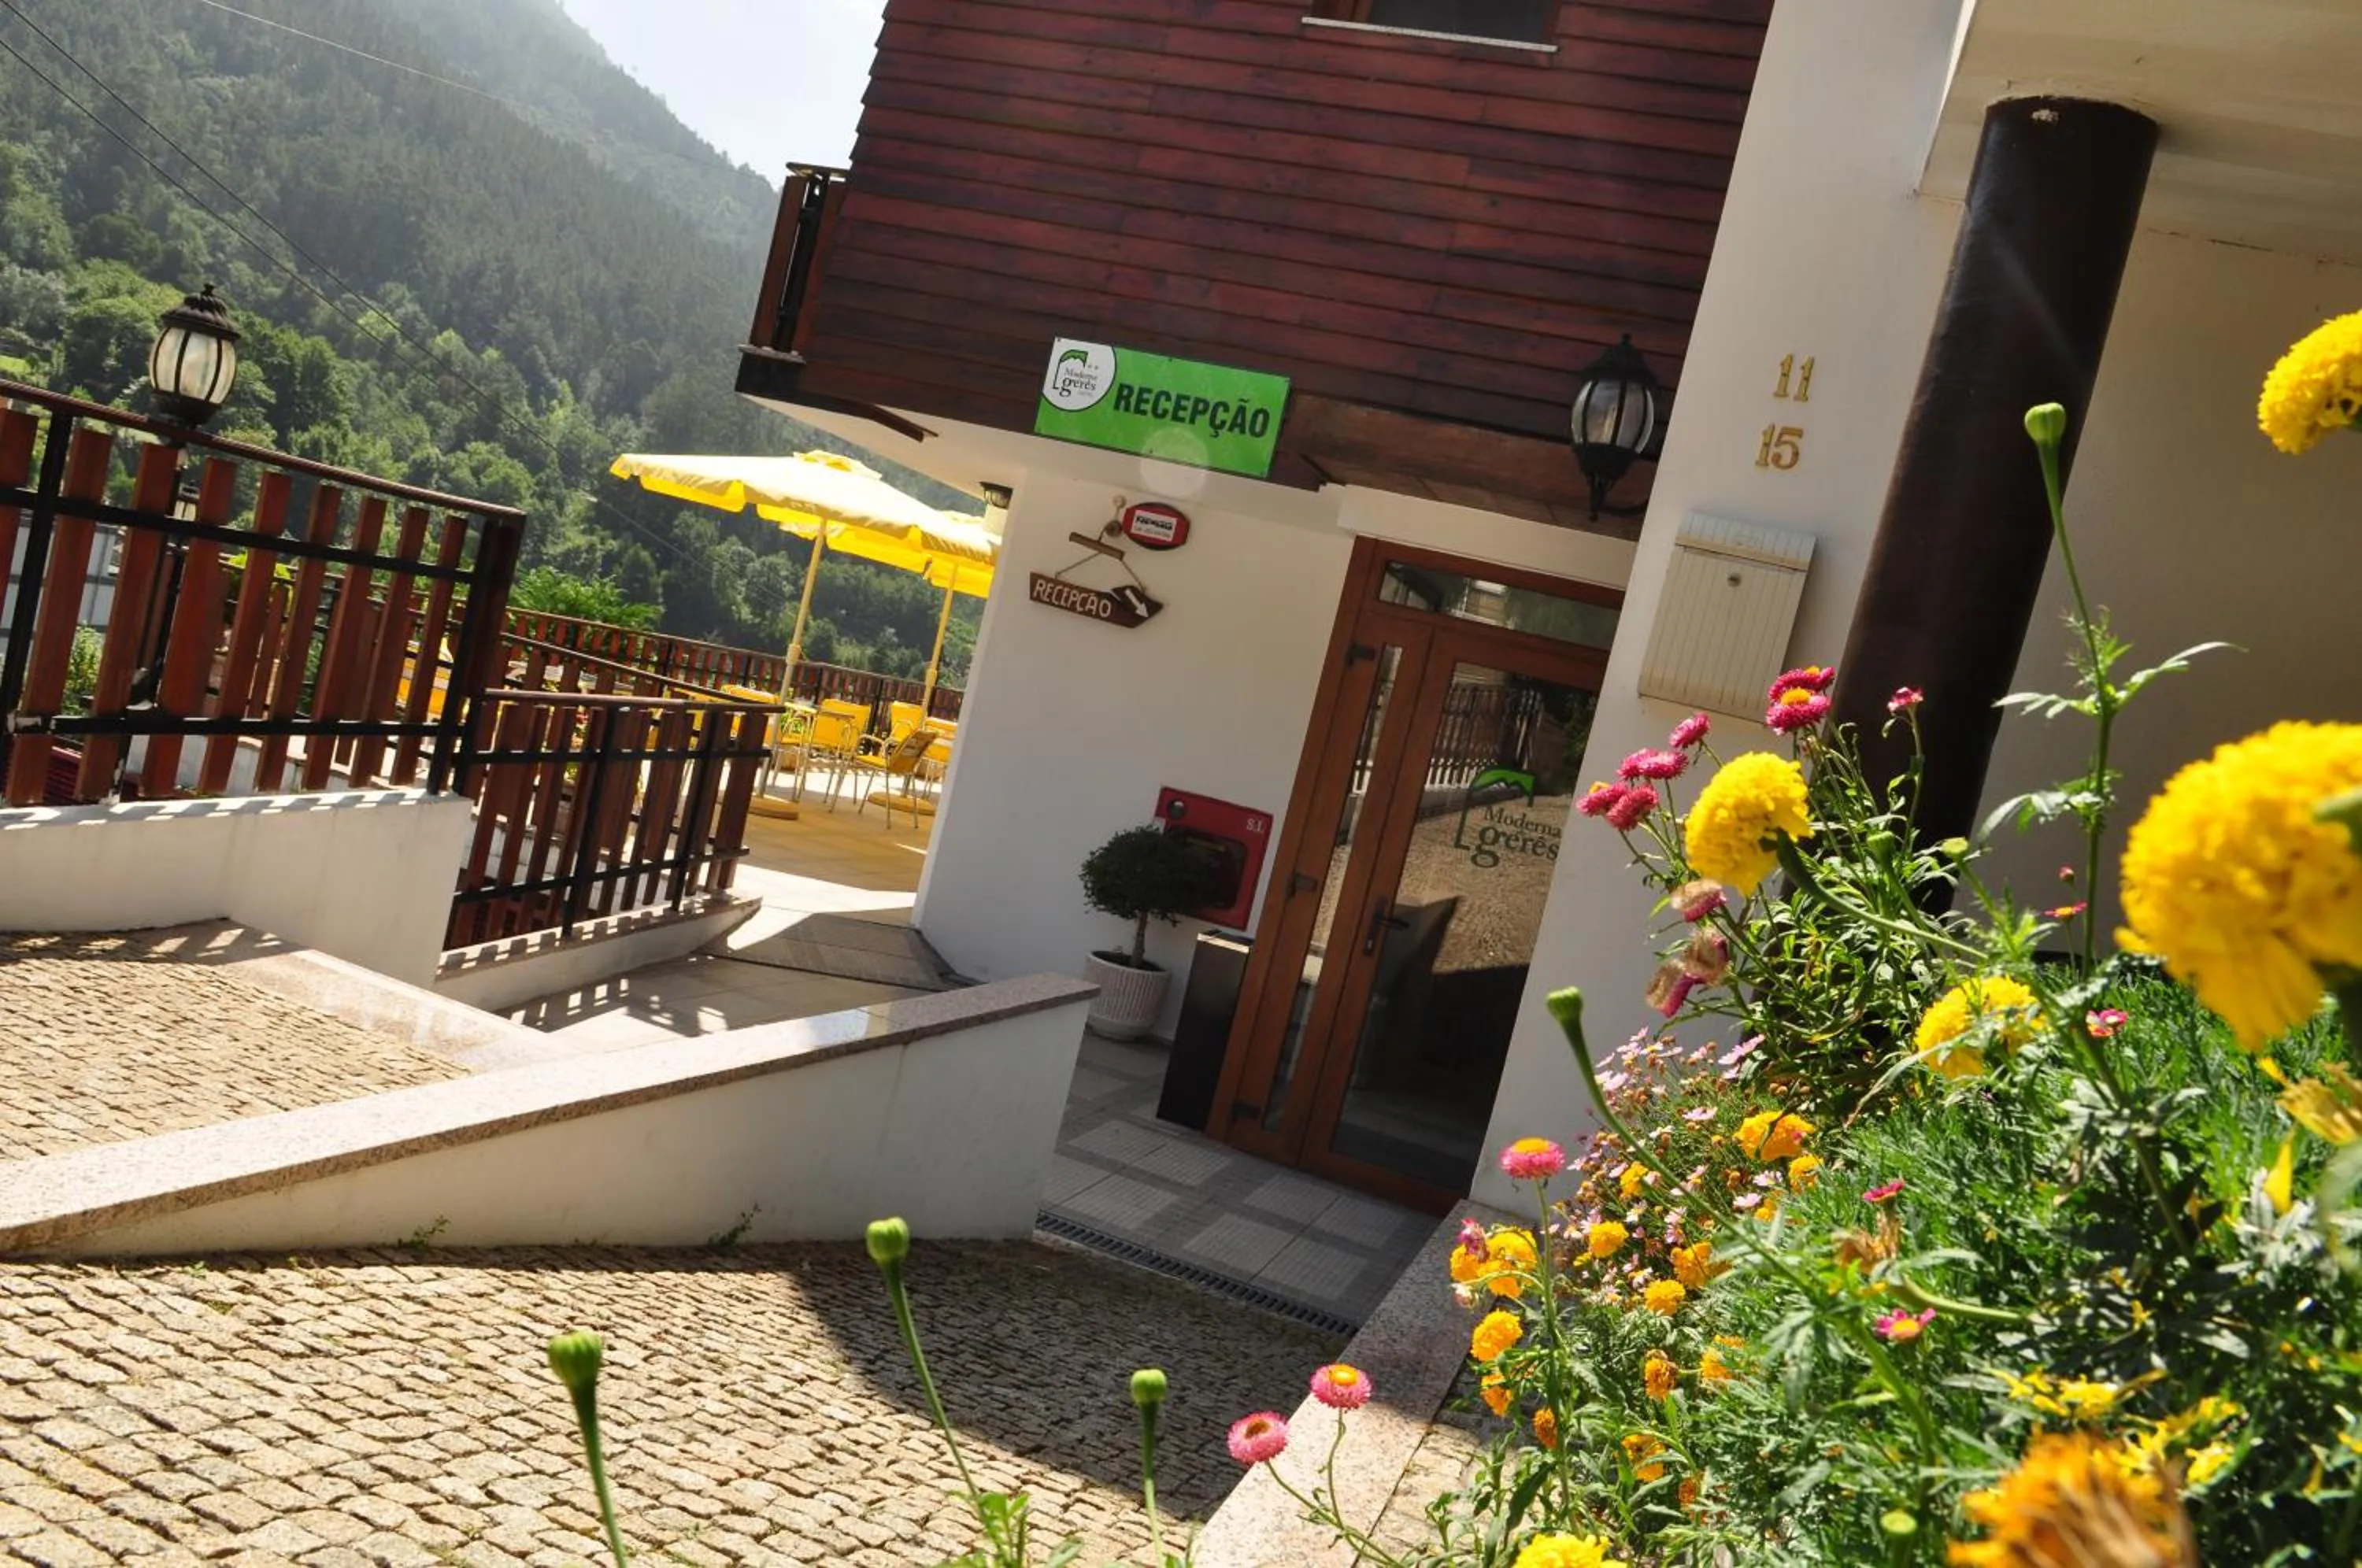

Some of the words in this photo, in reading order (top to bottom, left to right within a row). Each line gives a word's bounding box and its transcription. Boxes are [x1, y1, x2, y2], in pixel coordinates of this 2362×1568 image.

[1773, 353, 1815, 402] 11
[1113, 383, 1271, 438] RECEPÇÃO
[1755, 423, 1805, 470] 15
[1032, 579, 1113, 618] RECEPÇÃO
[1483, 805, 1562, 838] Moderna
[1470, 826, 1560, 868] gerês
